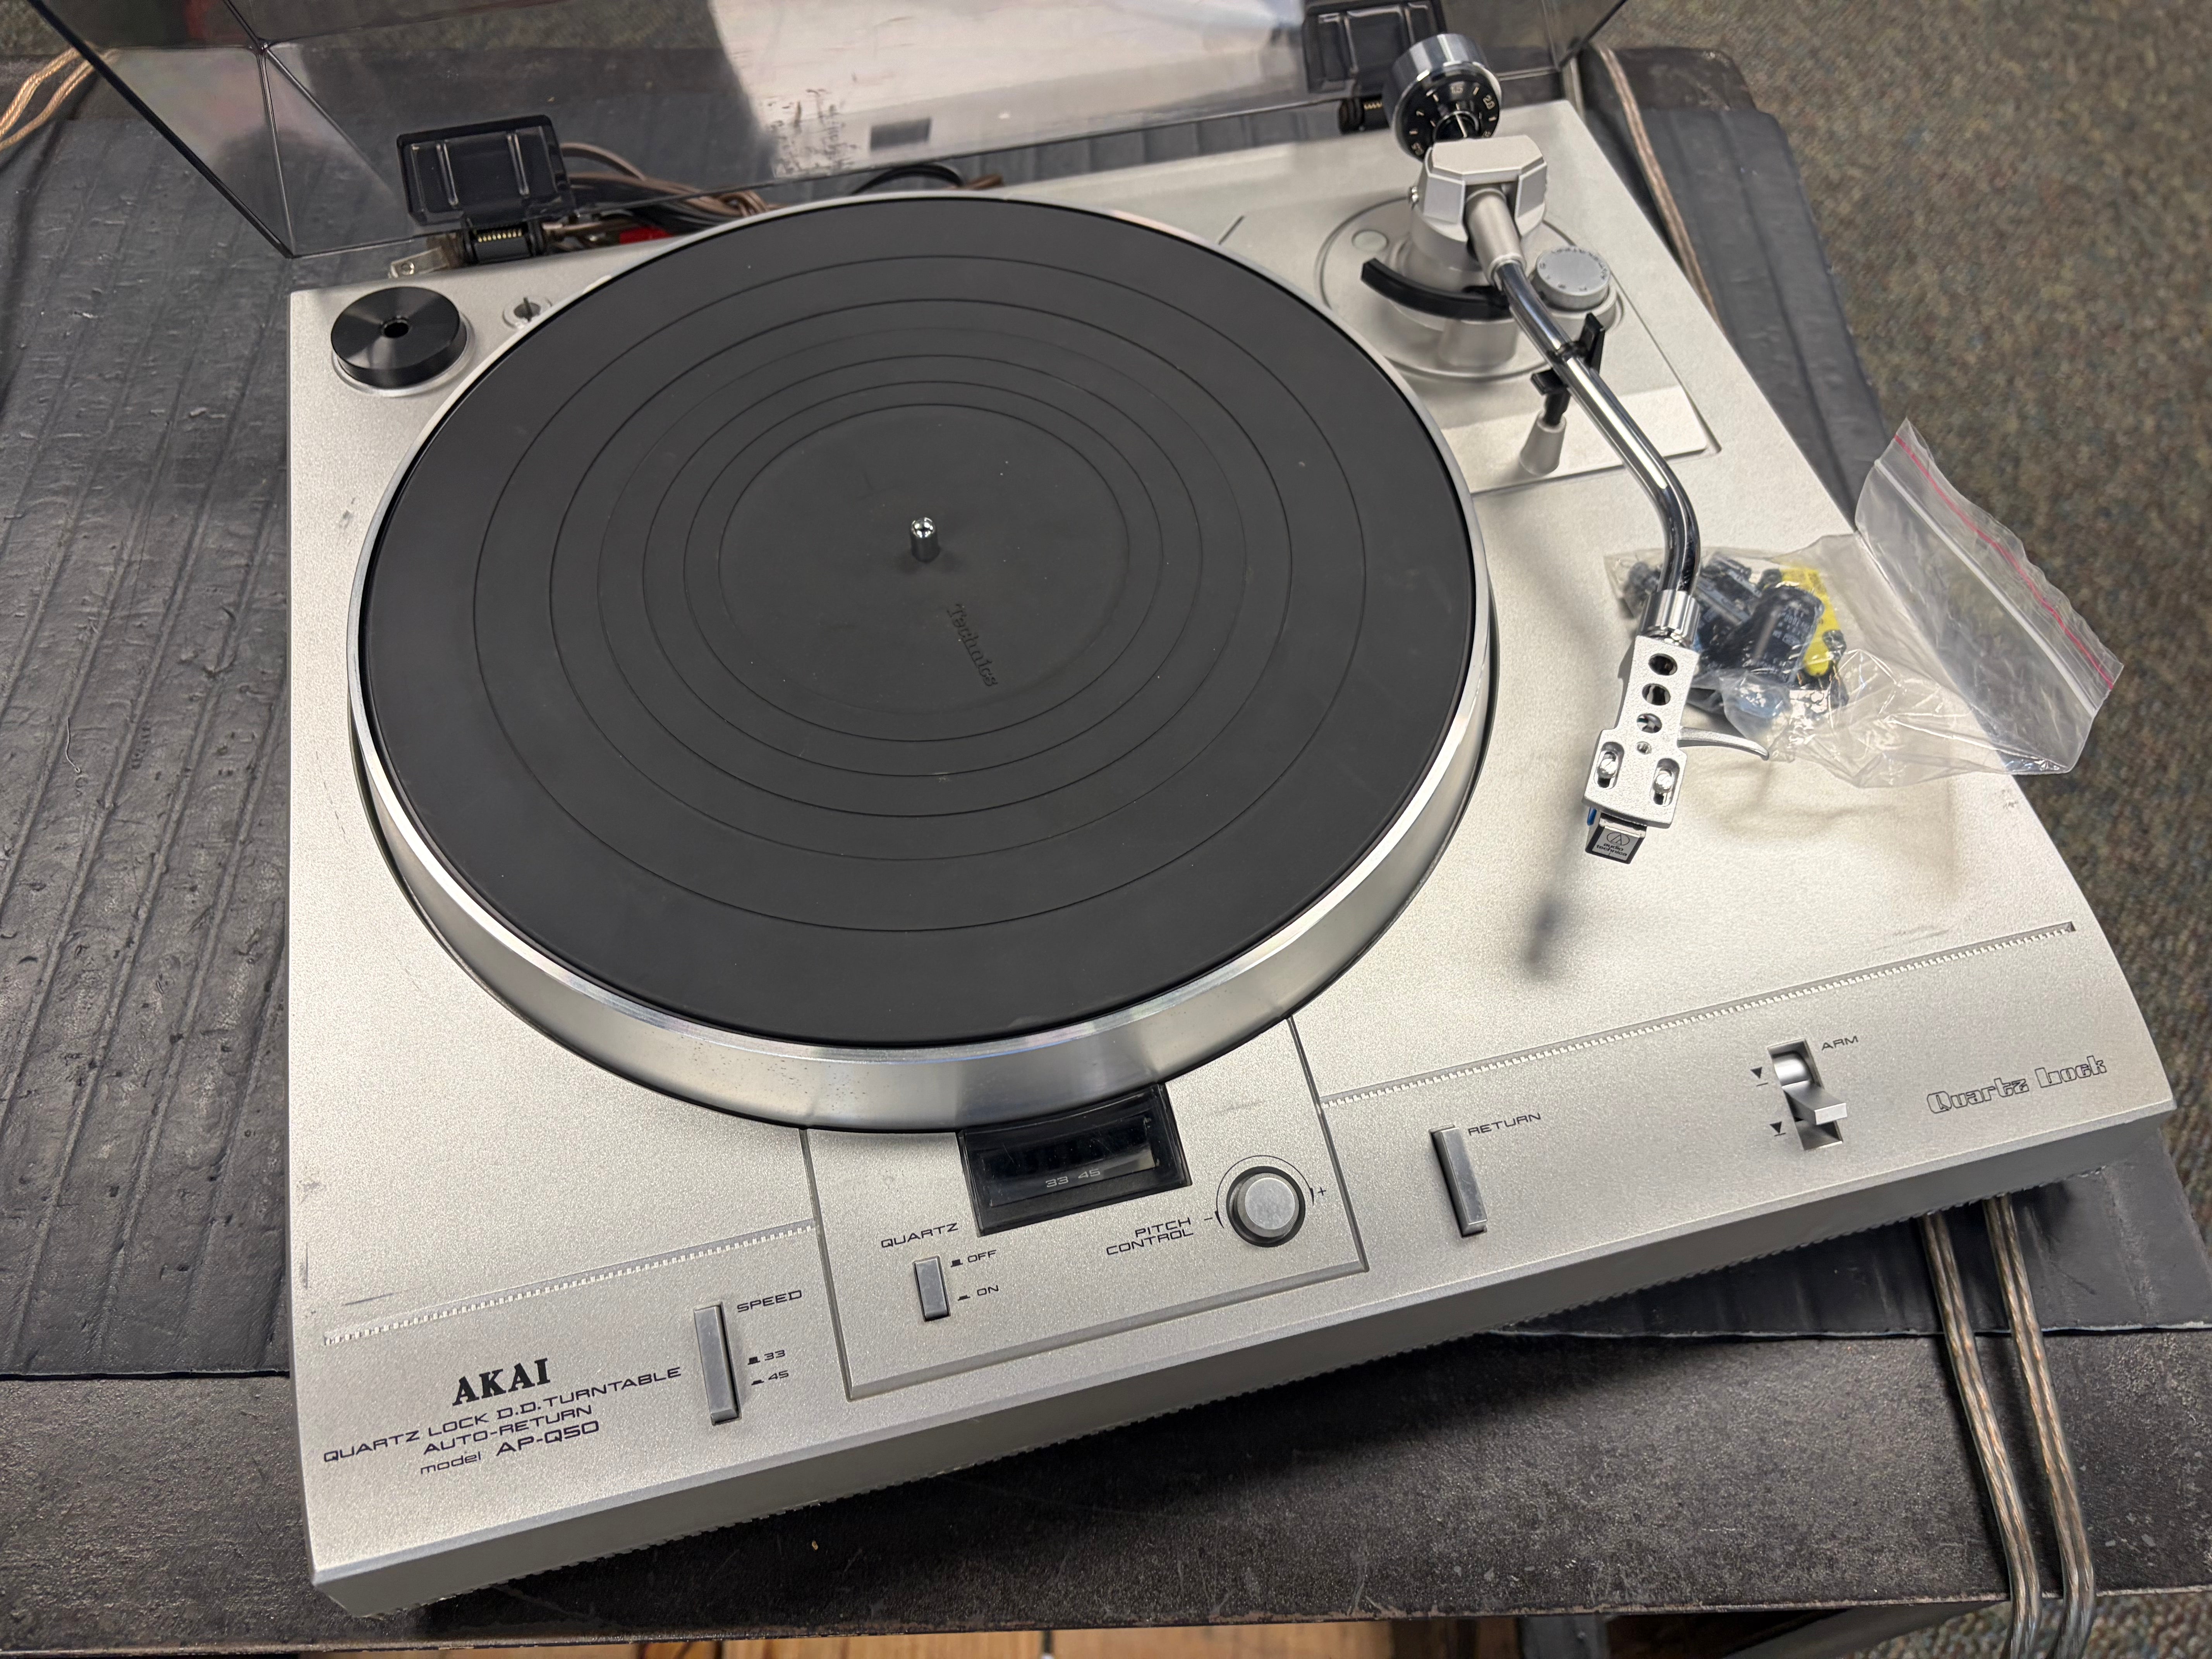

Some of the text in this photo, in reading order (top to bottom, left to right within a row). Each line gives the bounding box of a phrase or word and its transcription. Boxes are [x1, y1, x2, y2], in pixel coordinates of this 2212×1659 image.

[947, 603, 998, 687] Technics
[1596, 845, 1627, 857] technica
[1821, 1035, 1859, 1051] ARM
[1927, 1055, 2107, 1114] Quartz Lock
[1468, 1112, 1541, 1136] RETURN
[1045, 1168, 1101, 1188] 33 45
[881, 1222, 958, 1248] QUARTZ
[1135, 1217, 1191, 1238] PITCH
[1106, 1229, 1194, 1255] CONTROL
[968, 1249, 997, 1263] OFF
[737, 1290, 802, 1312] SPEED
[977, 1285, 999, 1296] ON
[764, 1350, 786, 1361] 33
[452, 1358, 551, 1406] AKAI
[768, 1370, 789, 1381] 45
[324, 1430, 420, 1462] QUARTZ
[428, 1412, 489, 1437] LOCK
[423, 1405, 592, 1455] AUTO-RETURN
[421, 1420, 599, 1475] model AP-Q50
